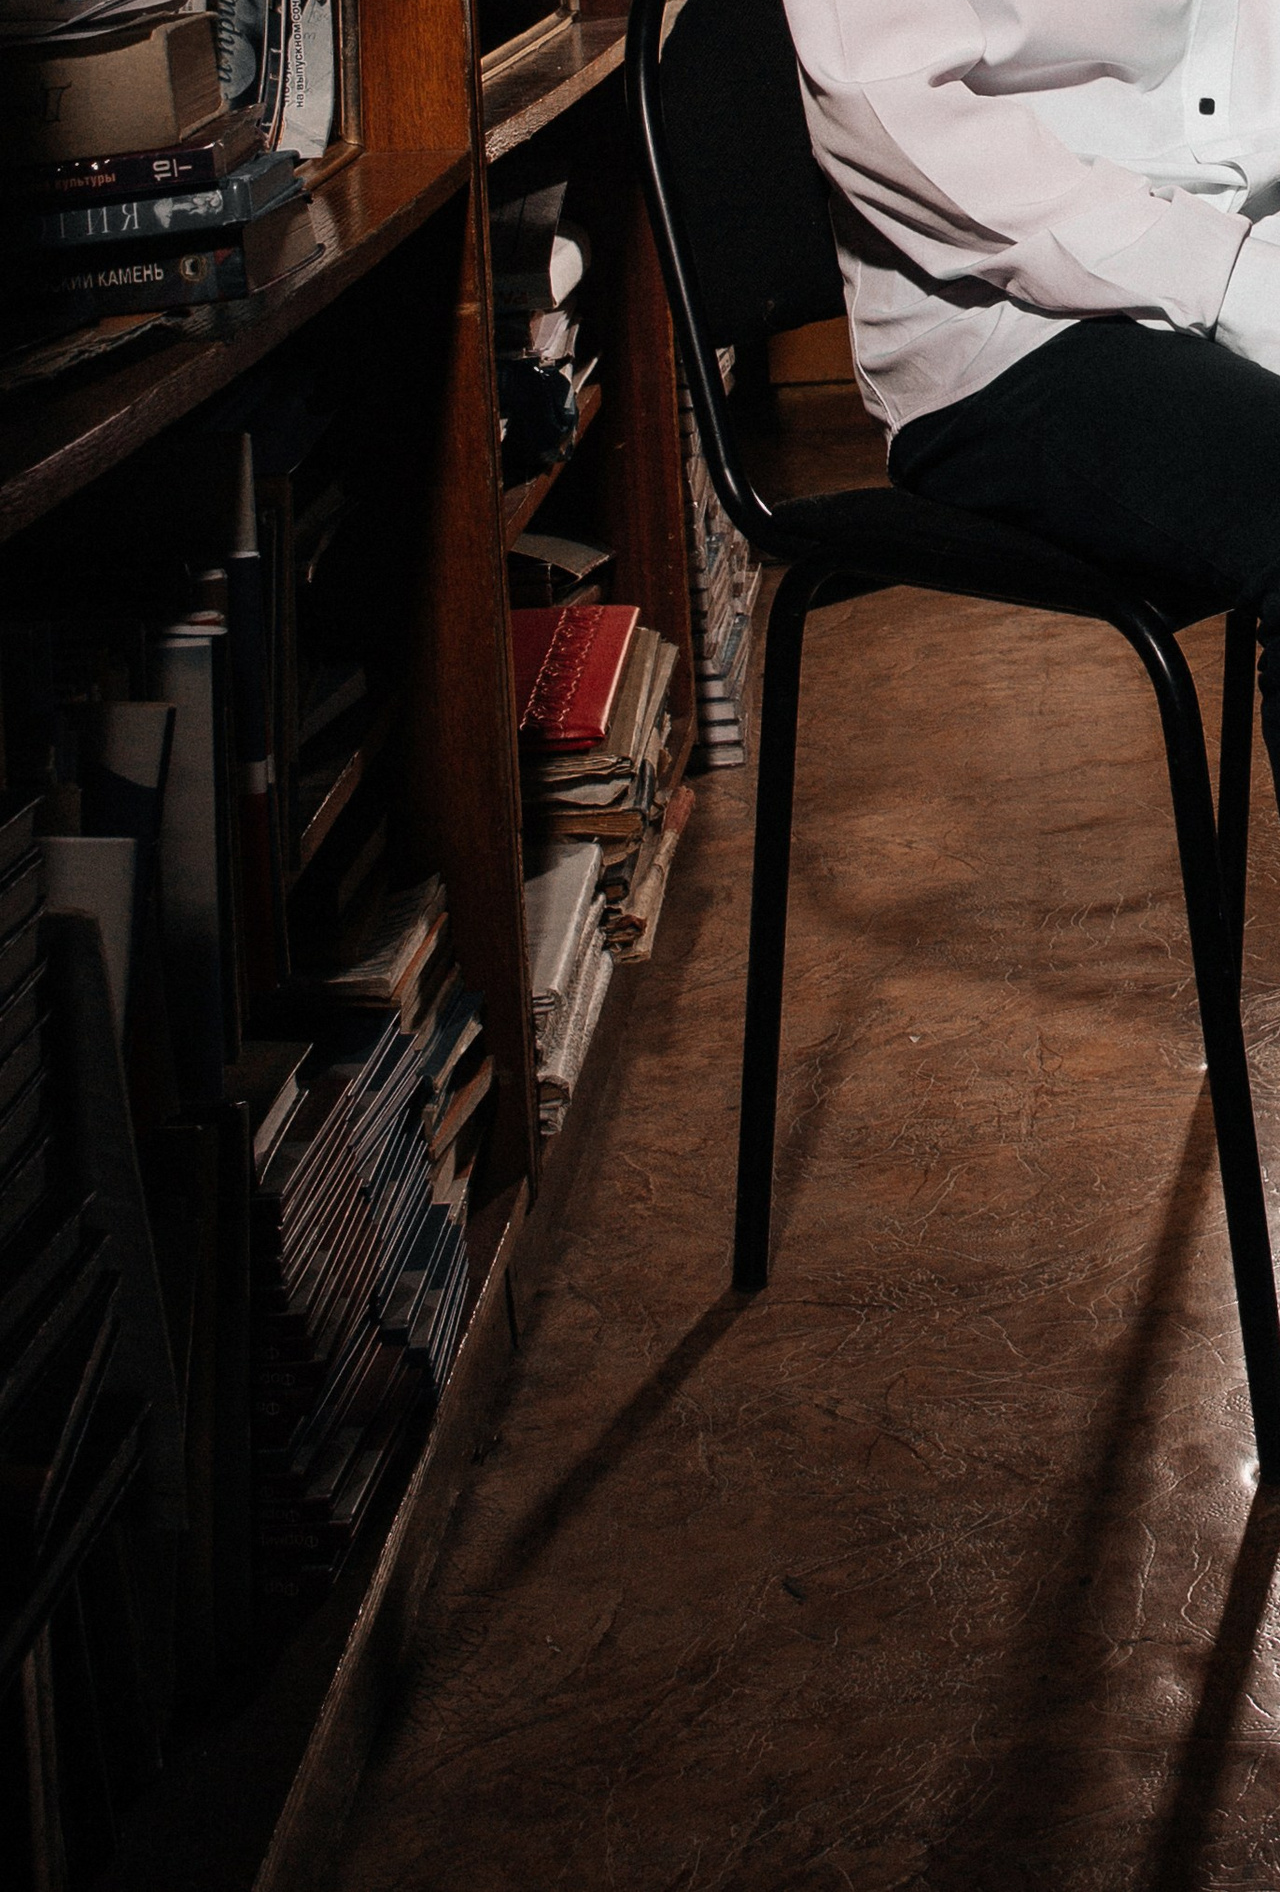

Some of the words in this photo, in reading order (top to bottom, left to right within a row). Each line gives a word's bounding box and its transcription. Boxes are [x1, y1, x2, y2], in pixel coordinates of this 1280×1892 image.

[294, 22, 307, 89] выпускном
[54, 172, 117, 192] культуры
[98, 262, 165, 289] КАМЕНЬ
